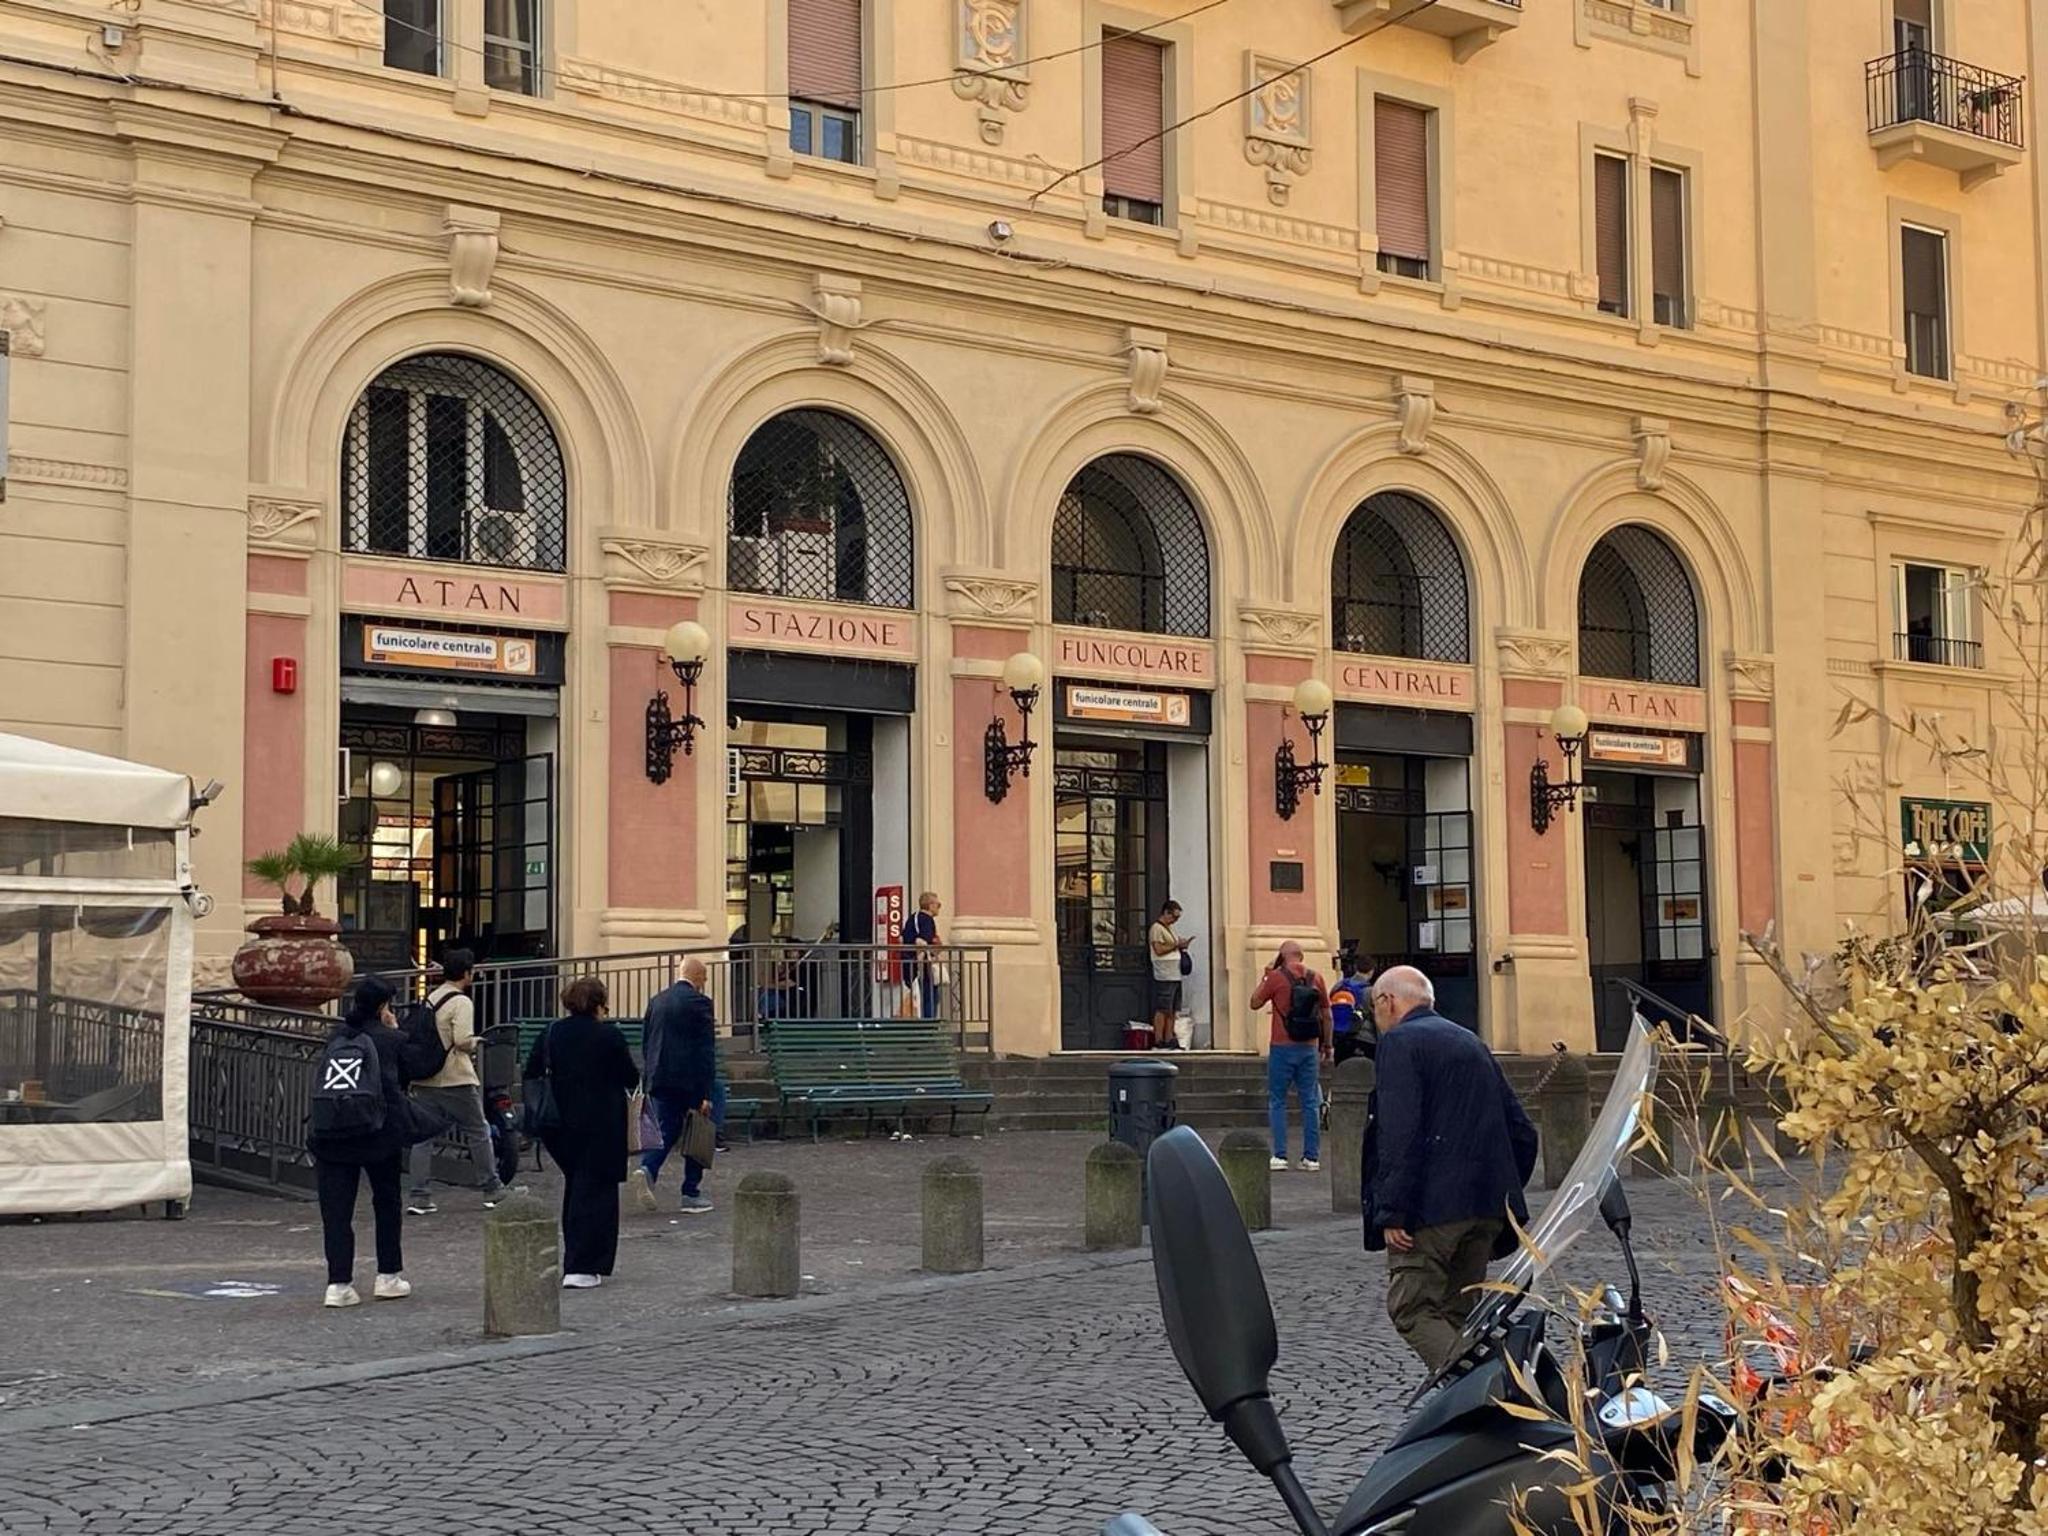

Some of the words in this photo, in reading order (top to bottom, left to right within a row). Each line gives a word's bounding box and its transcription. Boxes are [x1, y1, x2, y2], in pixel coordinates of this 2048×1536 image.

[377, 633, 440, 651] funicolare
[442, 640, 492, 655] centrale
[744, 610, 898, 646] STAZIONE
[1062, 639, 1202, 673] FUNICOLARE
[1343, 666, 1462, 696] CENTRALE
[1075, 692, 1121, 706] funicolare
[1122, 698, 1158, 709] centrale
[889, 895, 901, 937] SOS
